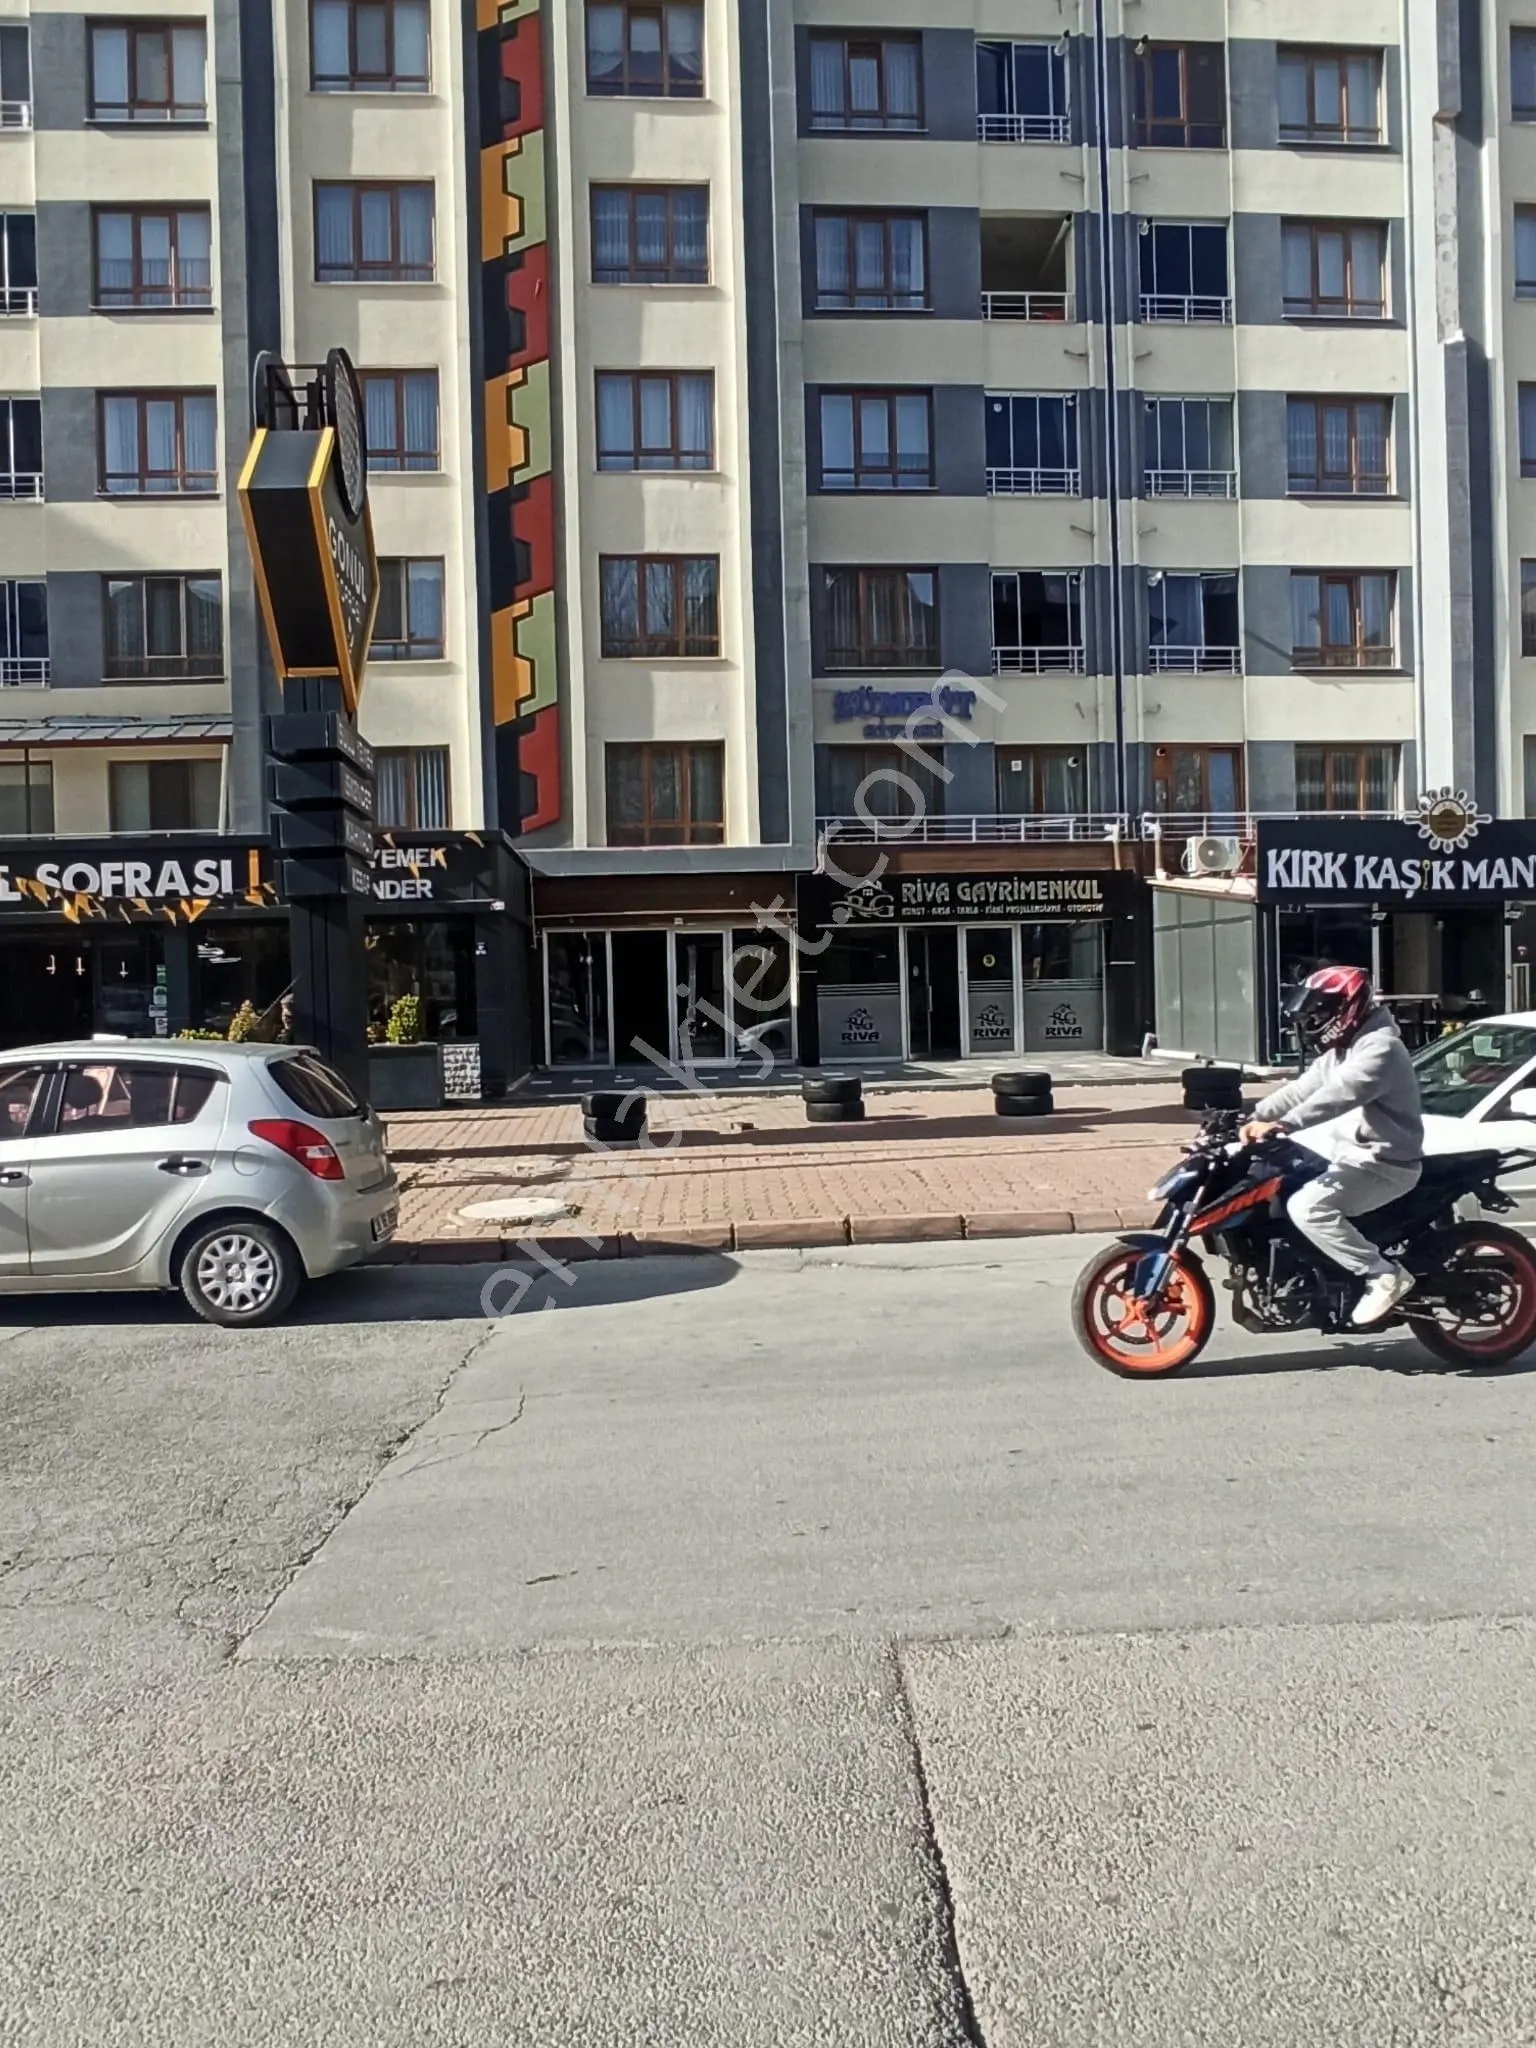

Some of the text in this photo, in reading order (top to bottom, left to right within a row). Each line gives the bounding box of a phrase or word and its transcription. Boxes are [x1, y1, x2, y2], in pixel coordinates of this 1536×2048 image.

[36, 858, 233, 898] SOFRASI
[1266, 848, 1347, 888] KIRK
[1462, 854, 1536, 890] MAN
[901, 876, 1104, 905] RİVA GAYRİMENKUL
